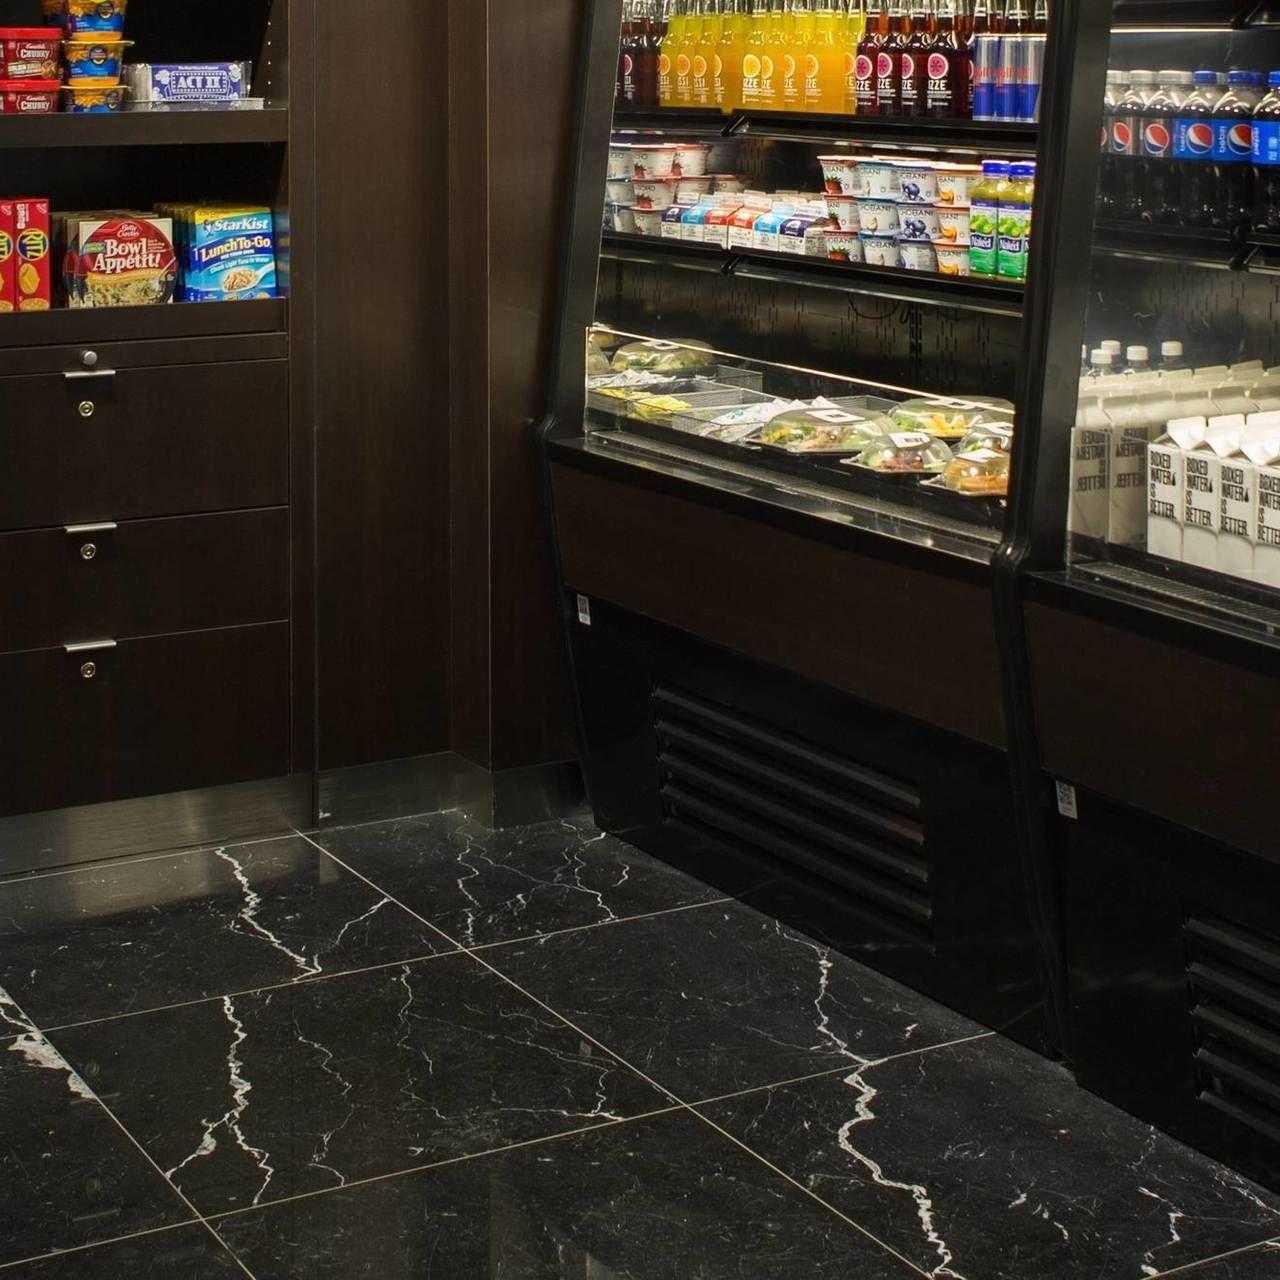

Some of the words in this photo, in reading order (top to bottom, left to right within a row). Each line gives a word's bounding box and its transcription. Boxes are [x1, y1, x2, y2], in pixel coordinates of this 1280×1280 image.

[20, 49, 50, 60] CHUNKY
[176, 75, 200, 90] ACT
[20, 101, 51, 111] CHUNKY
[213, 218, 268, 231] StarKist
[22, 230, 44, 258] RITZ
[104, 238, 148, 257] Bowl
[201, 238, 238, 262] Lunch
[1150, 451, 1171, 469] BOXED
[1186, 457, 1209, 476] BOXED
[1150, 467, 1171, 486] WATER
[1186, 473, 1209, 492] WATER
[1221, 465, 1244, 485] BOXED
[1221, 482, 1244, 502] WATER
